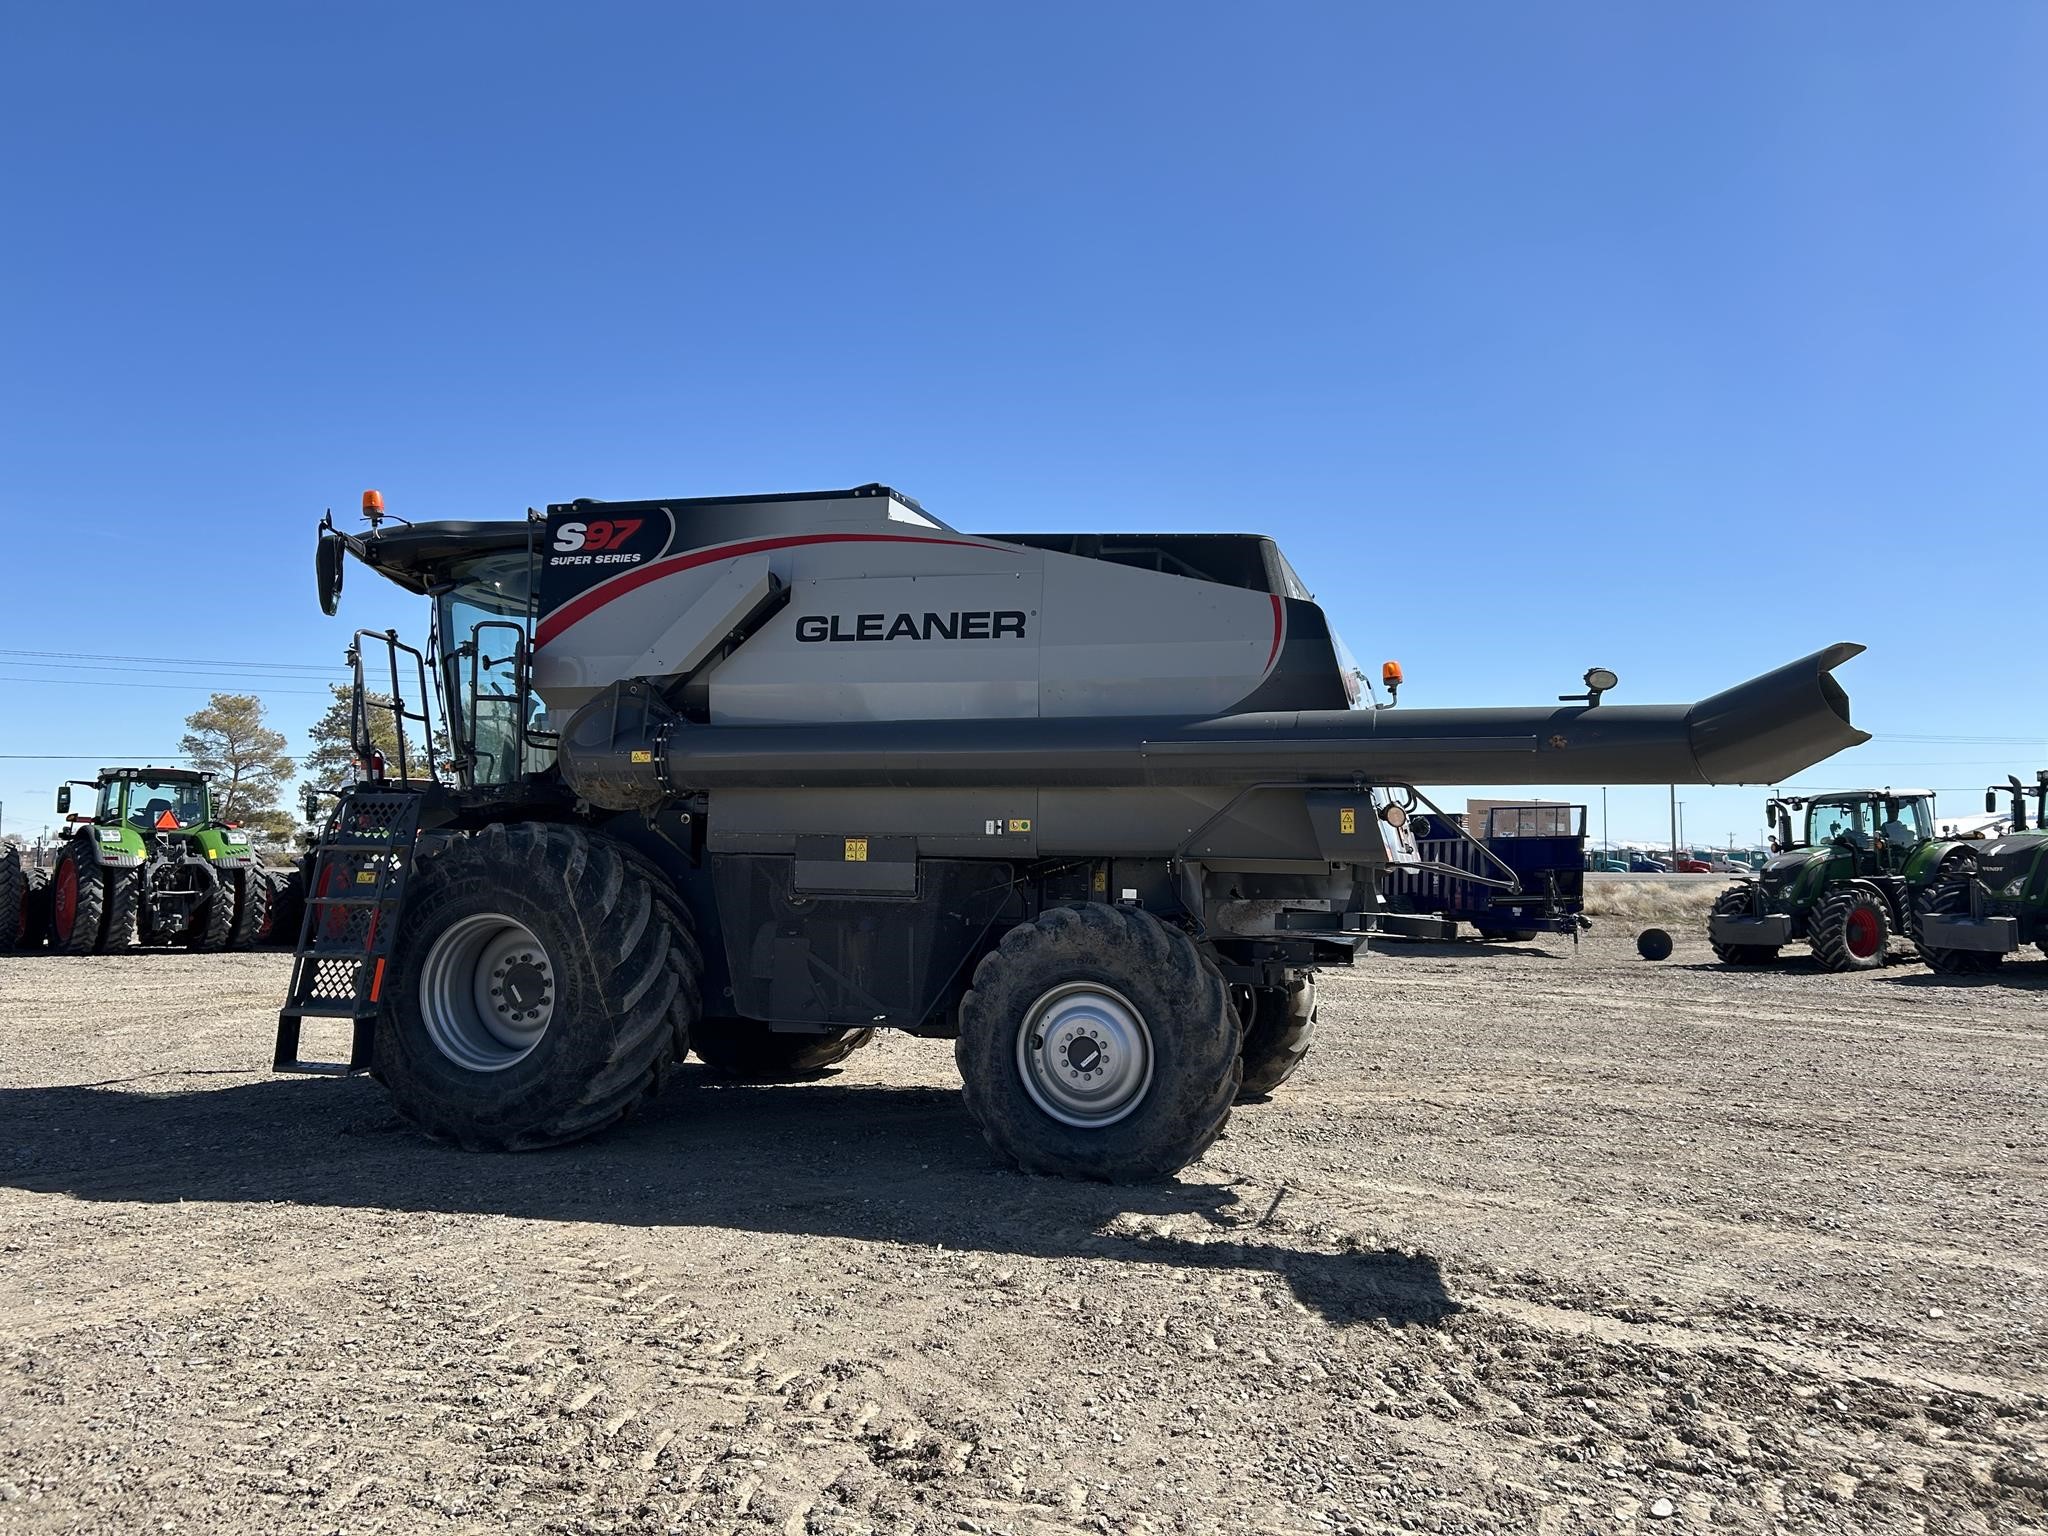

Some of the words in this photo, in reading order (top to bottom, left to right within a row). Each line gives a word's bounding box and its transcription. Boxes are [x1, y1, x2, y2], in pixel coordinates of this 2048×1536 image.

[553, 519, 645, 552] S97
[550, 555, 592, 566] SUPER
[594, 553, 641, 564] SERIES
[795, 610, 1027, 642] GLEANER
